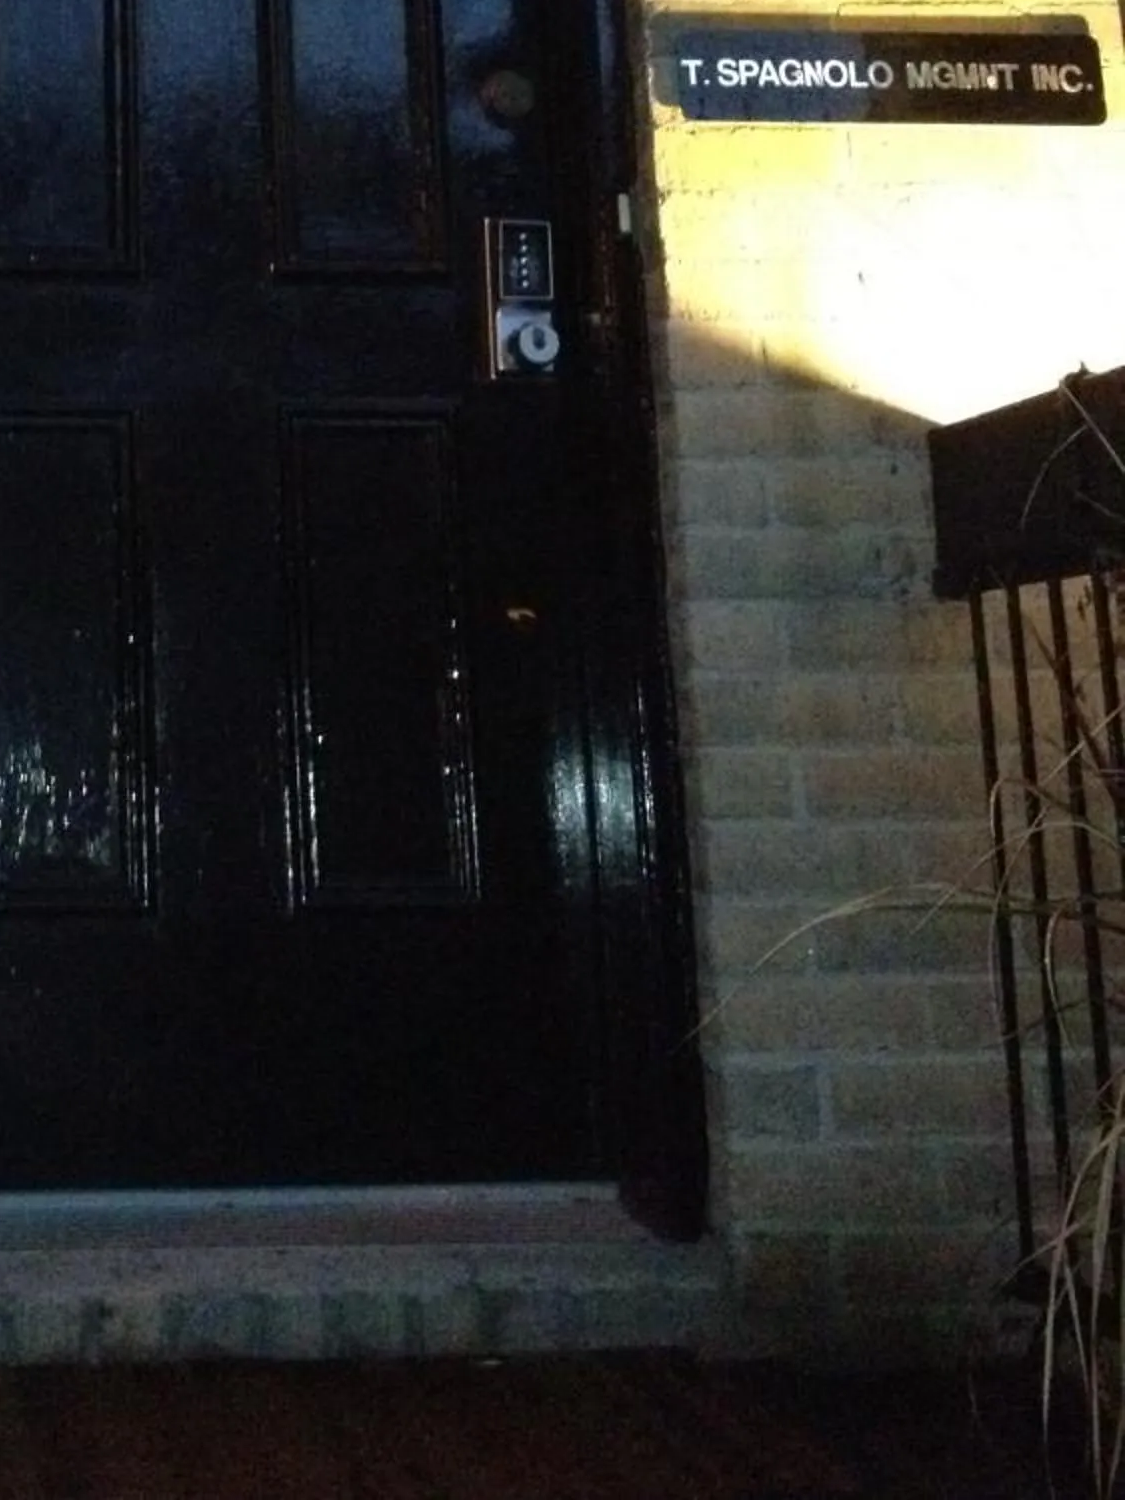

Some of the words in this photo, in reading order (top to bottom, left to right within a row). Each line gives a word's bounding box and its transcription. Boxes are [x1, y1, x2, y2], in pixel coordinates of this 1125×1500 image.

[680, 58, 711, 87] T.
[716, 58, 895, 90] SPAGNOLO
[1030, 63, 1095, 94] INC.
